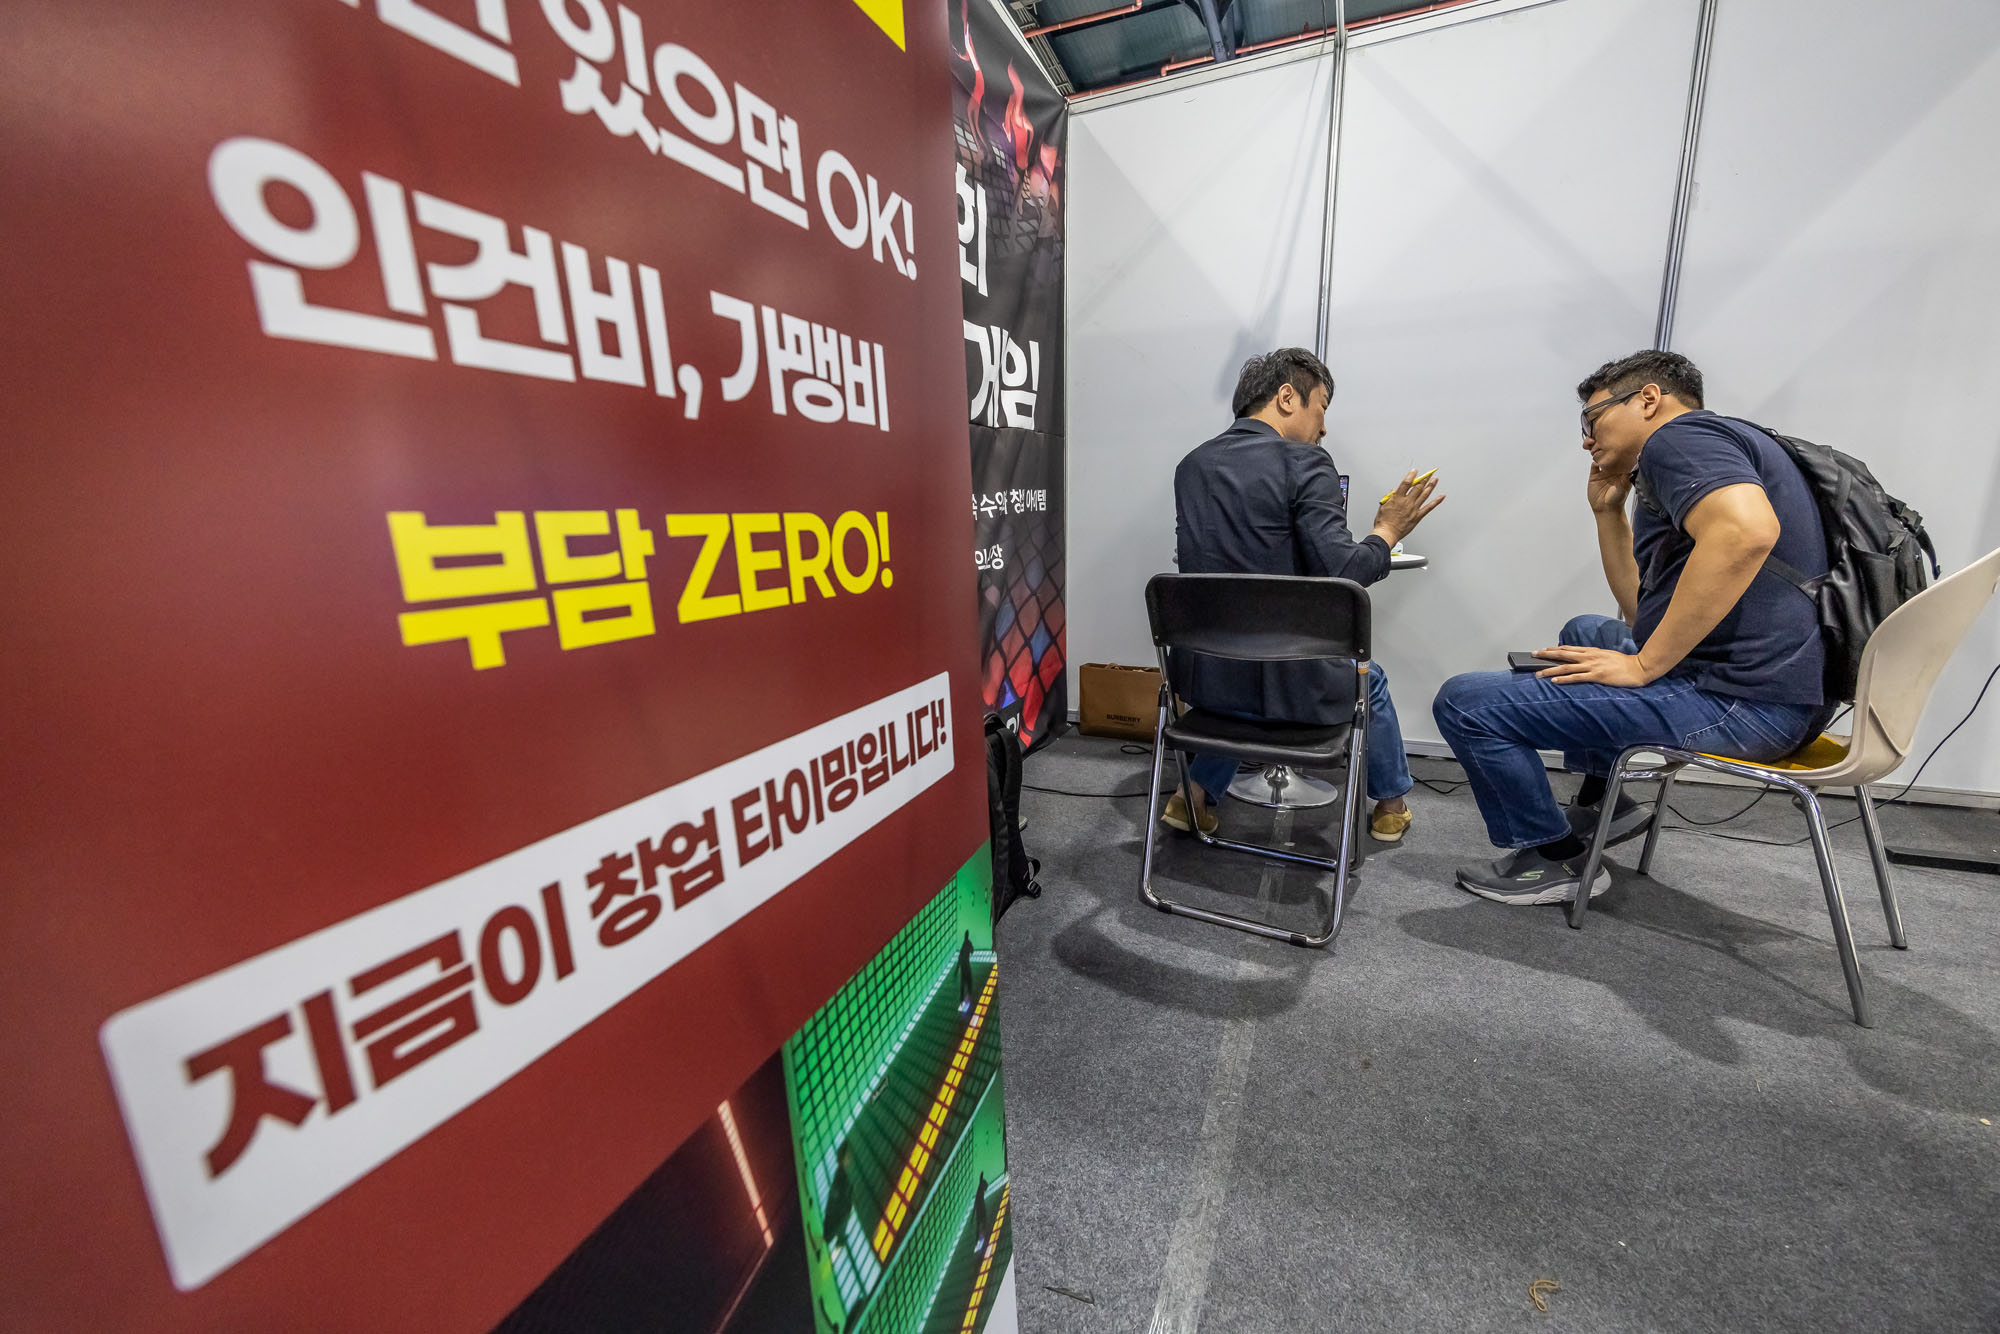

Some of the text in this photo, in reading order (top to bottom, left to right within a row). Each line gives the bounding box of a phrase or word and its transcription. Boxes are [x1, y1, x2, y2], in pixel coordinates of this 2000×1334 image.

[207, 137, 891, 432] 인건비, 가맹비
[539, 0, 810, 231] 있으면
[815, 149, 918, 281] OK!
[386, 508, 894, 671] 부담 ZERO!
[182, 697, 948, 1181] 지금이 창업 타이밍입니다!
